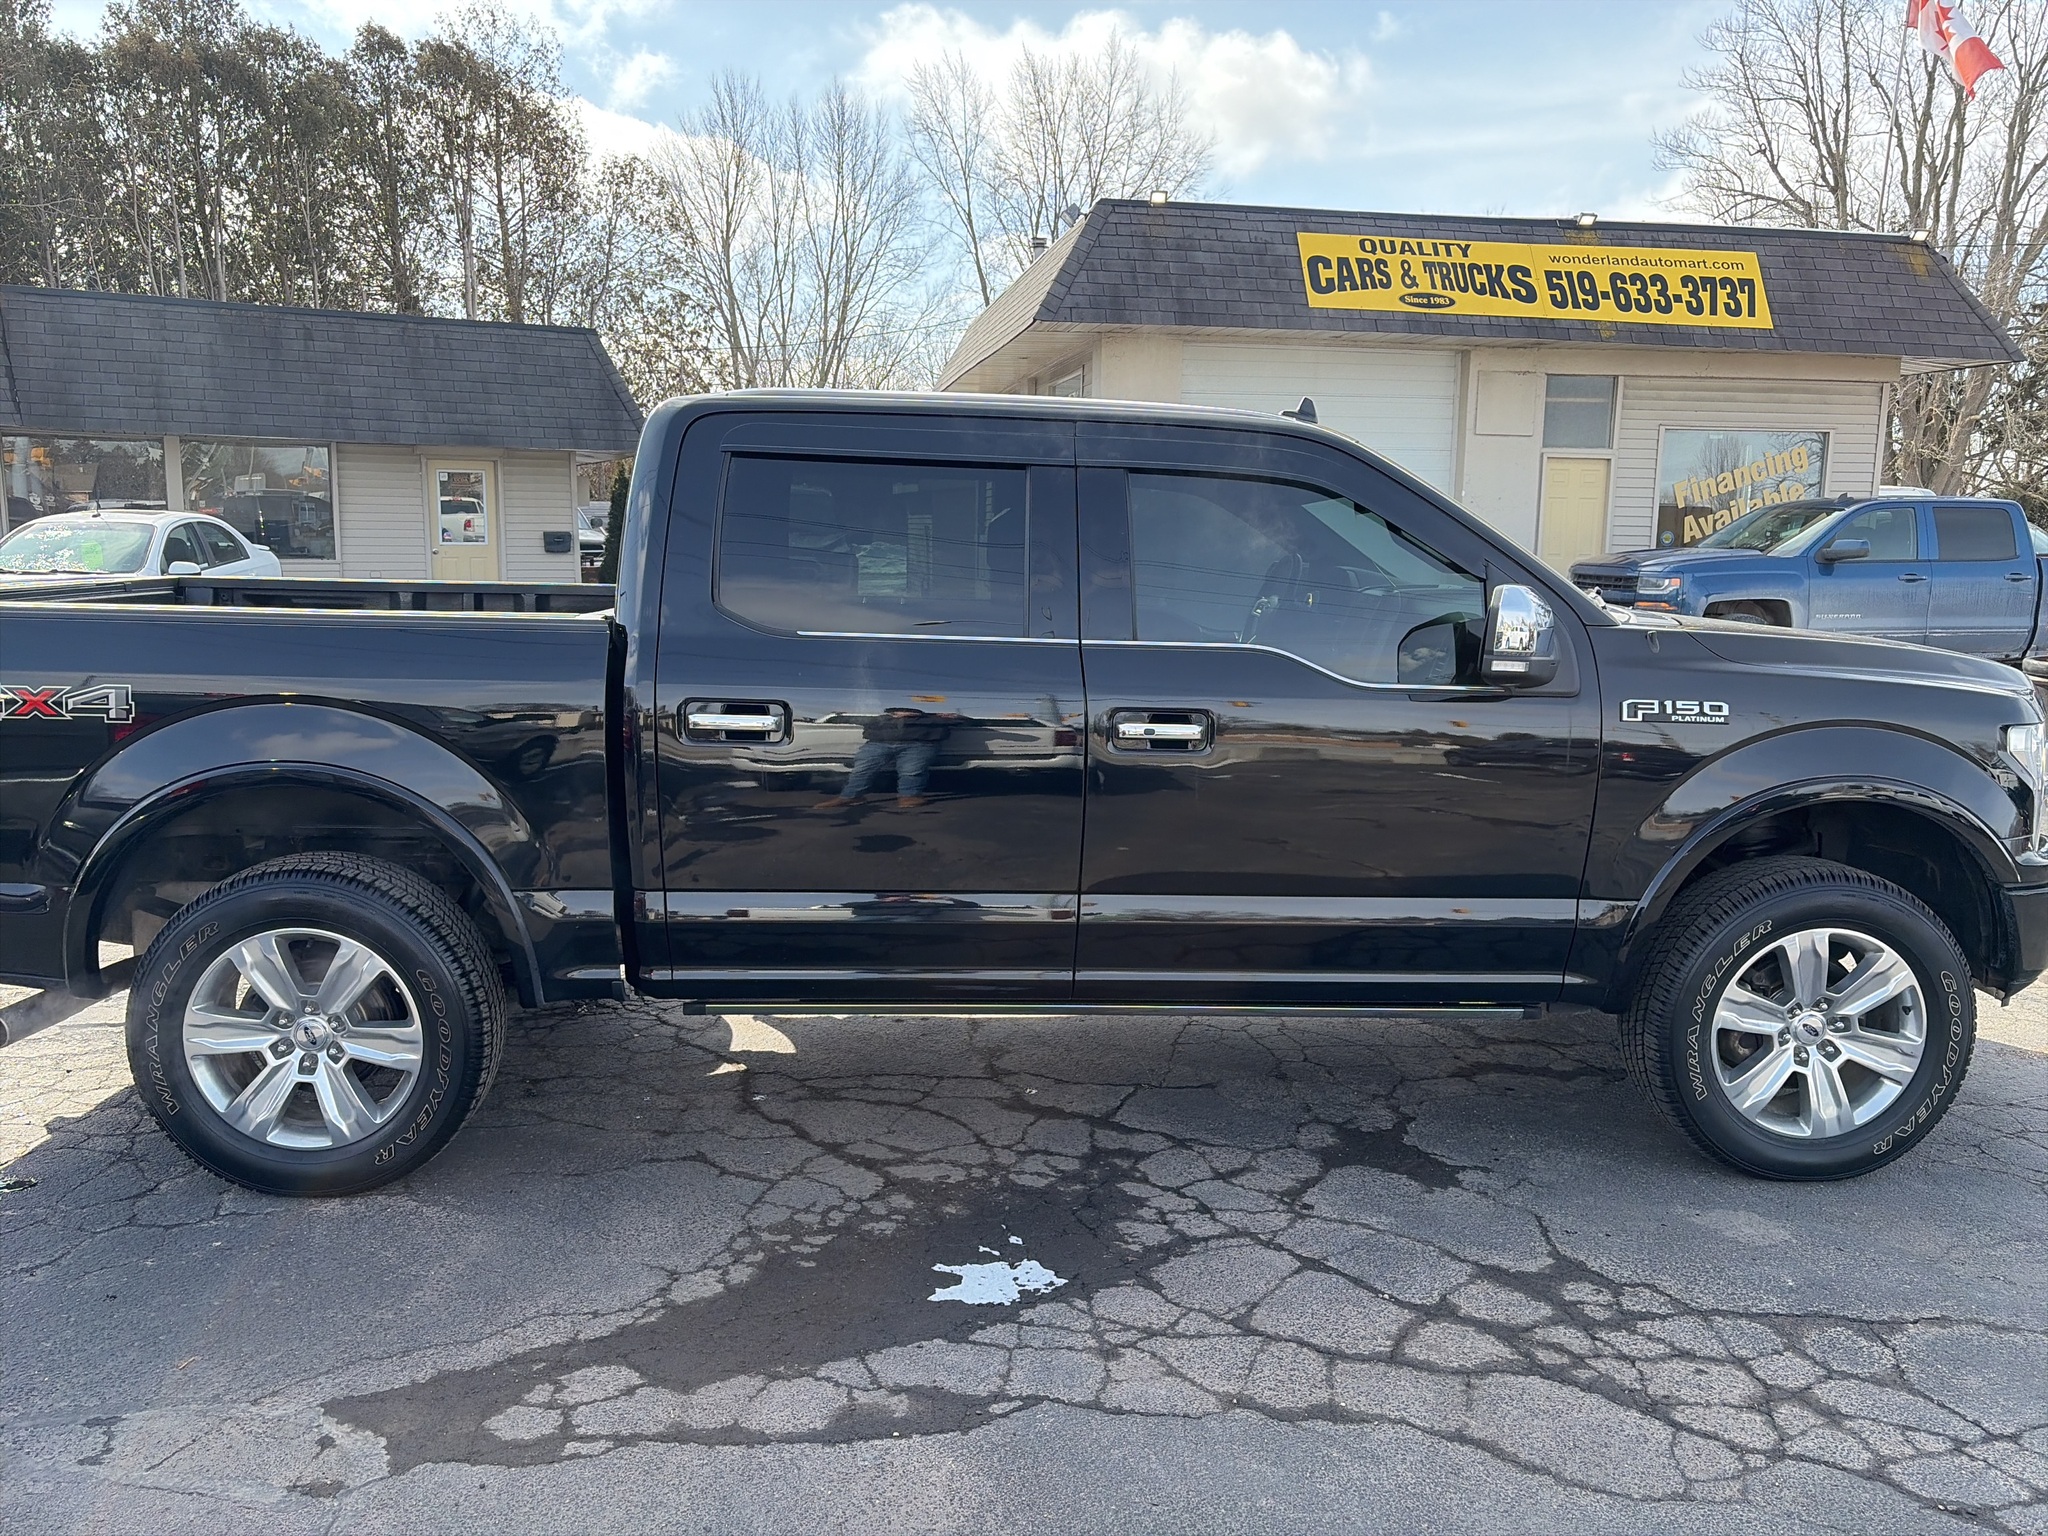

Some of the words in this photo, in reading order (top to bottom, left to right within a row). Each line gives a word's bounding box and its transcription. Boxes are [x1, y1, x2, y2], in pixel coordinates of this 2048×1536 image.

[1359, 238, 1471, 258] QUALITY
[1548, 254, 1745, 271] wonderlandautomart.com
[1306, 255, 1392, 295] CARS
[1400, 259, 1419, 289] &
[1422, 260, 1538, 304] TRUCKS
[1404, 295, 1428, 304] Since
[1430, 297, 1450, 305] 1983
[1544, 270, 1756, 318] 519-633-3737
[1673, 445, 1809, 510] Financing
[1671, 715, 1725, 723] PLATINUM
[143, 921, 219, 1116] WRANGLER
[1686, 919, 1773, 1100] WRANGLER
[374, 968, 453, 1166] GOODYEAR
[1873, 970, 1963, 1155] GOODYEAR
